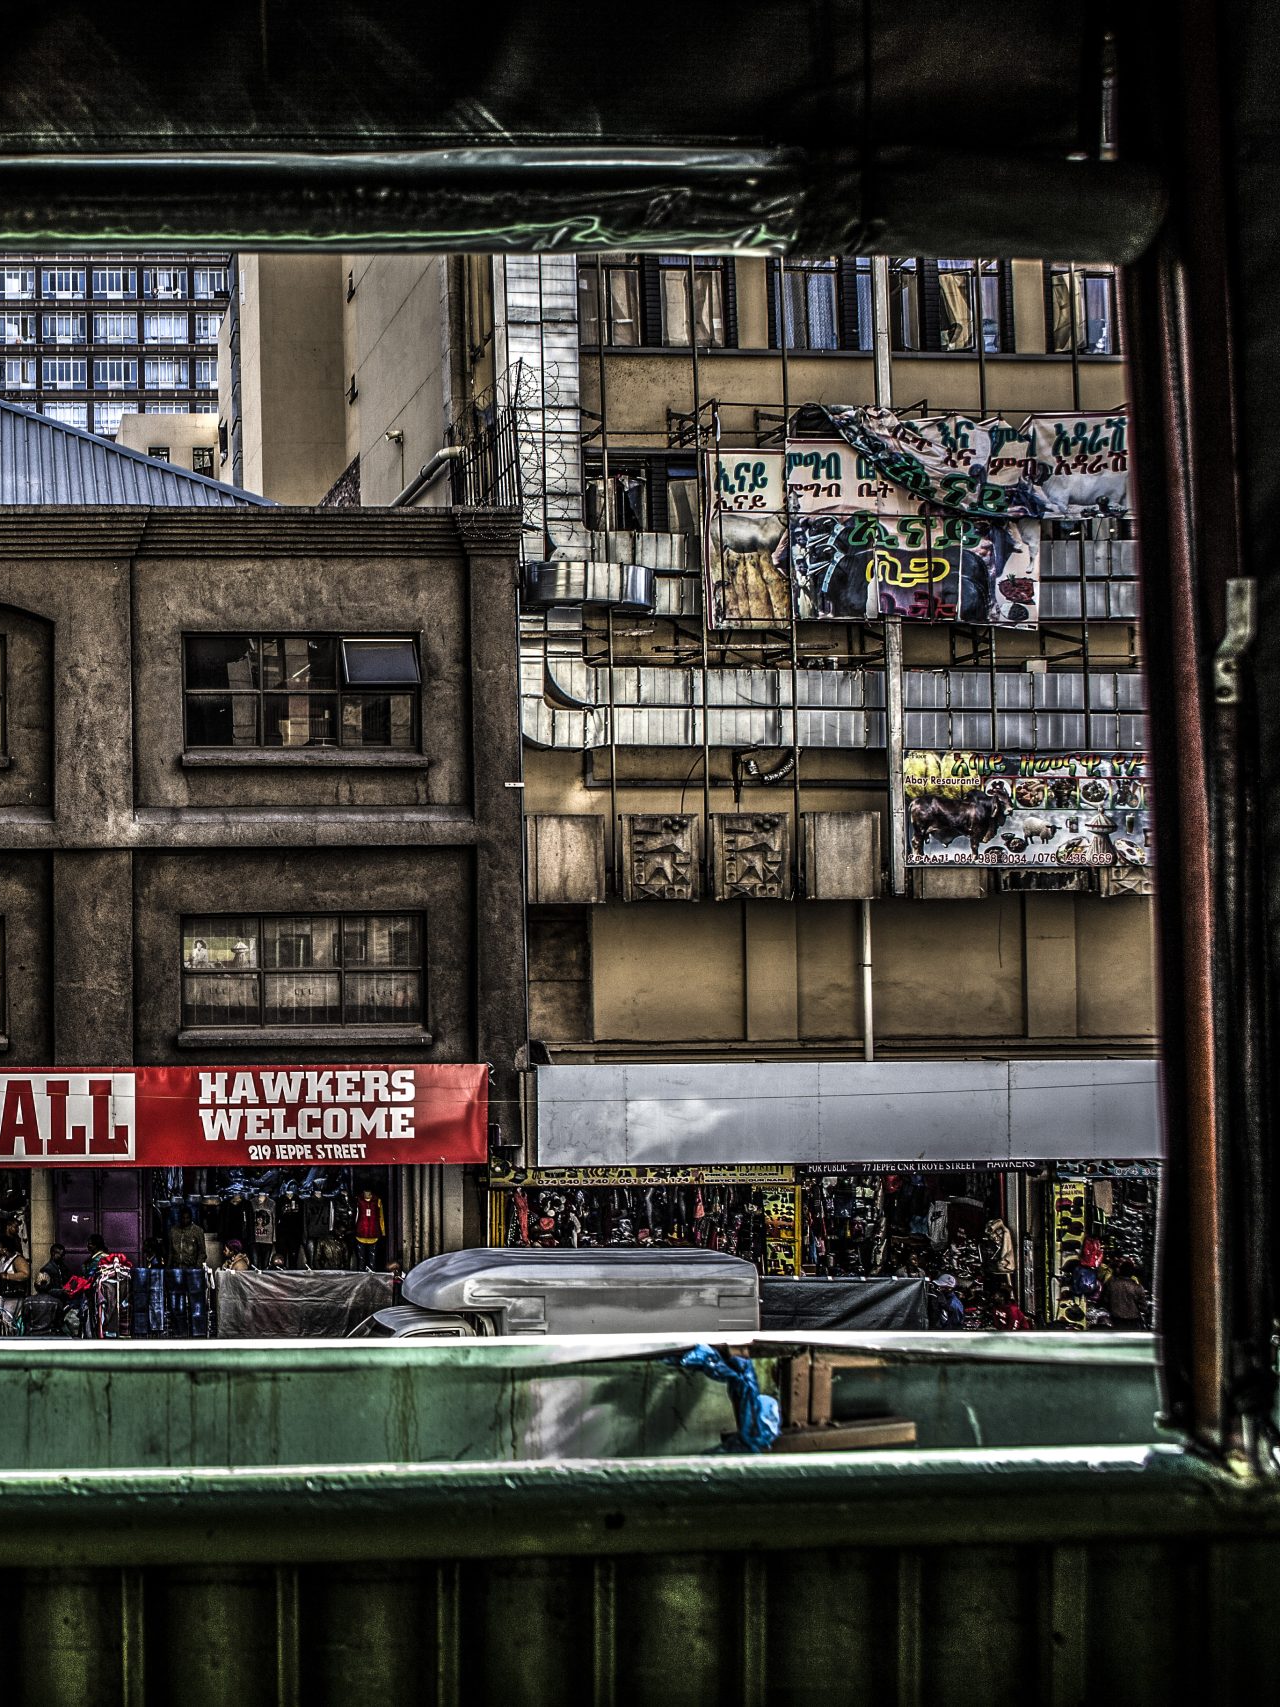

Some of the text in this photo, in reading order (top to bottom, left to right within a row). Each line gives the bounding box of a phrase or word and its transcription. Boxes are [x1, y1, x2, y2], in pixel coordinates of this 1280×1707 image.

[905, 776, 928, 787] Abay
[954, 853, 972, 864] 084
[1037, 852, 1056, 863] 076
[199, 1070, 416, 1104] HAWKERS
[199, 1107, 415, 1140] WELCOME
[248, 1143, 367, 1160] 219 JEPPE STREET
[823, 1163, 847, 1172] PUBLIC
[872, 1163, 896, 1171] JEPPE
[897, 1163, 915, 1171] CNR
[946, 1162, 976, 1170] STREET
